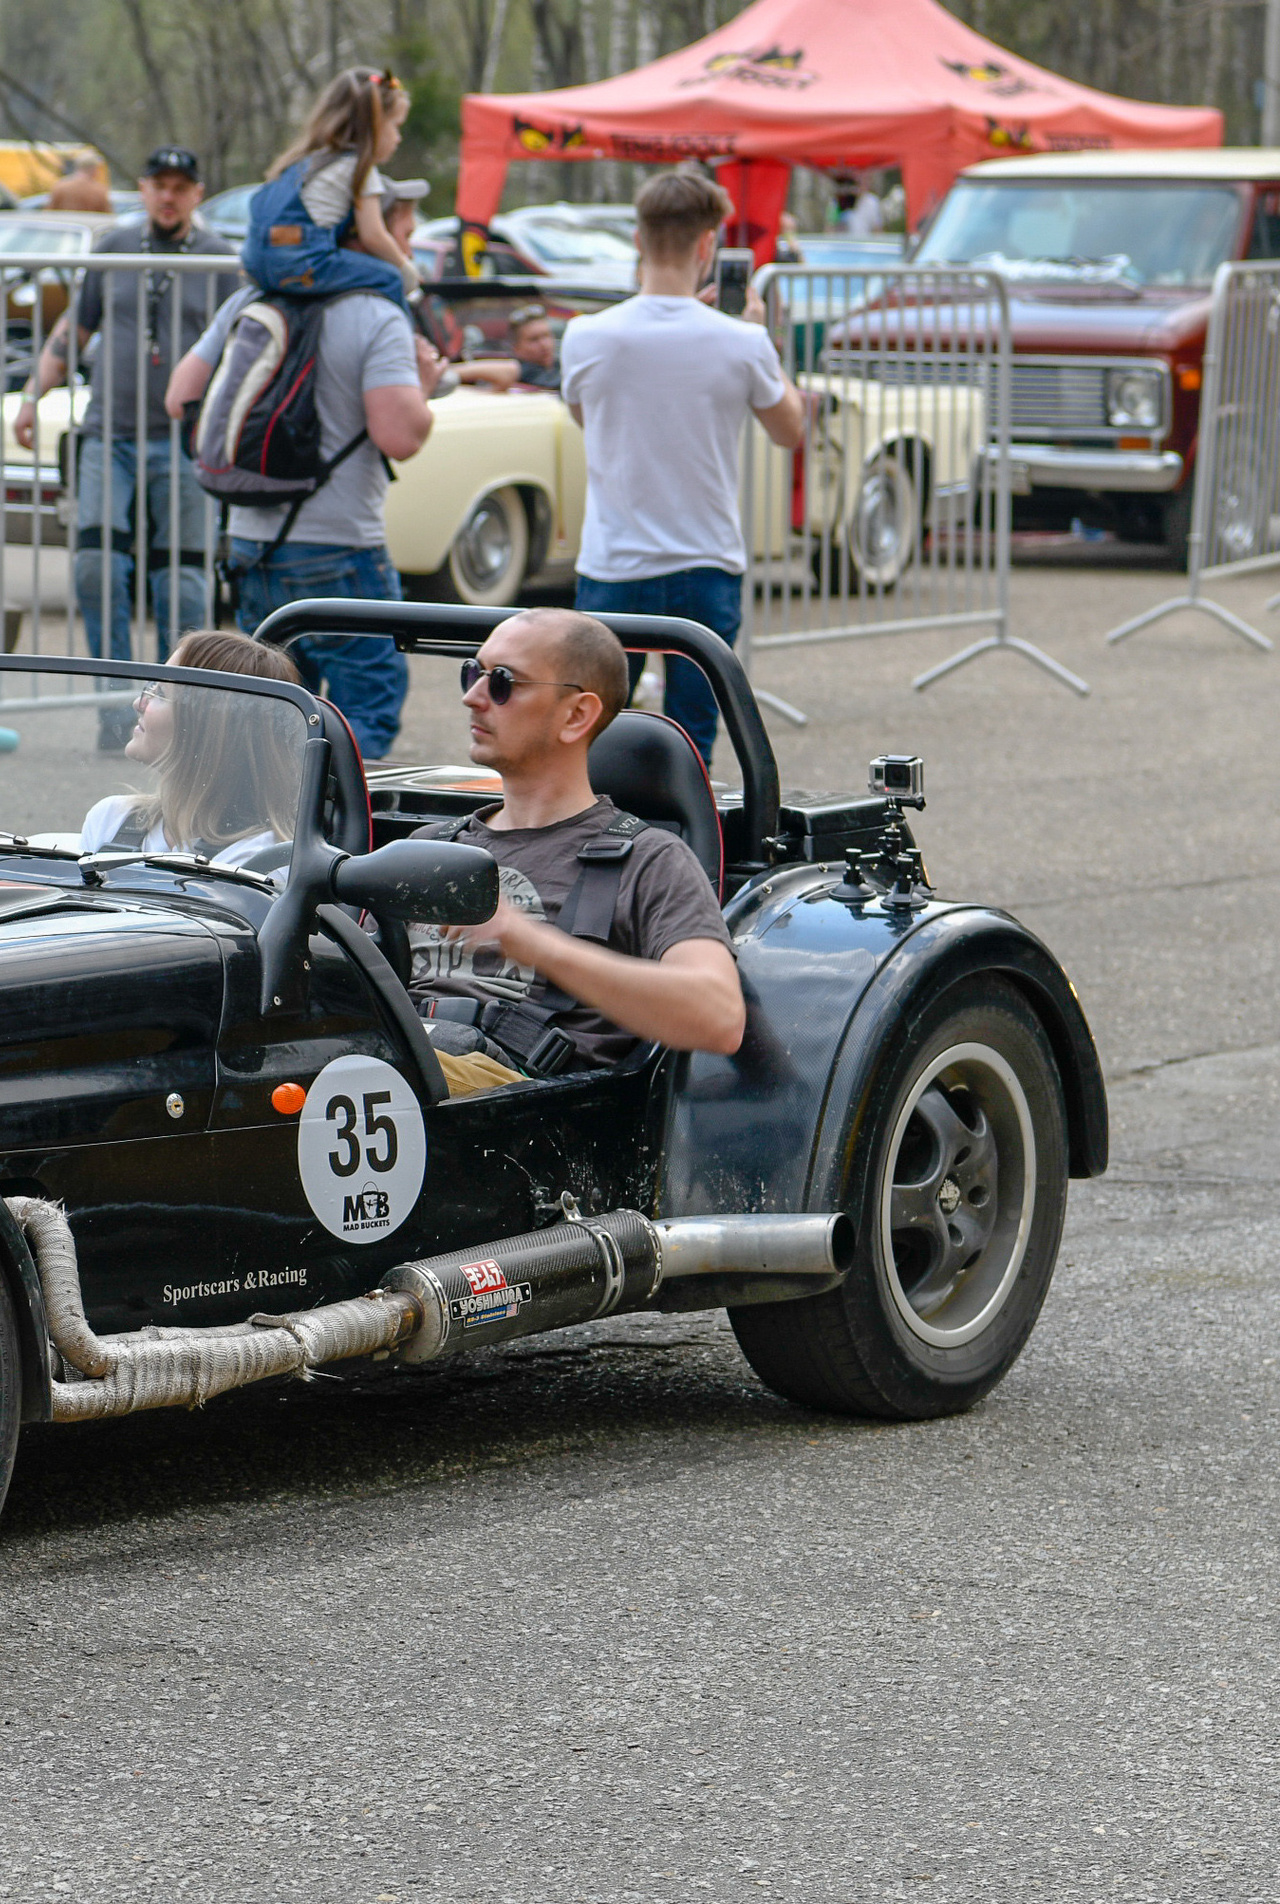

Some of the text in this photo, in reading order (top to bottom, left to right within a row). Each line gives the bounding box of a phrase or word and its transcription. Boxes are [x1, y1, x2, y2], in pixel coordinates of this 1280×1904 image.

[326, 1091, 398, 1177] 35
[343, 1219, 390, 1232] MAD BUCKETS
[163, 1278, 240, 1306] Sportscars
[460, 1287, 523, 1315] YOSHIMURA
